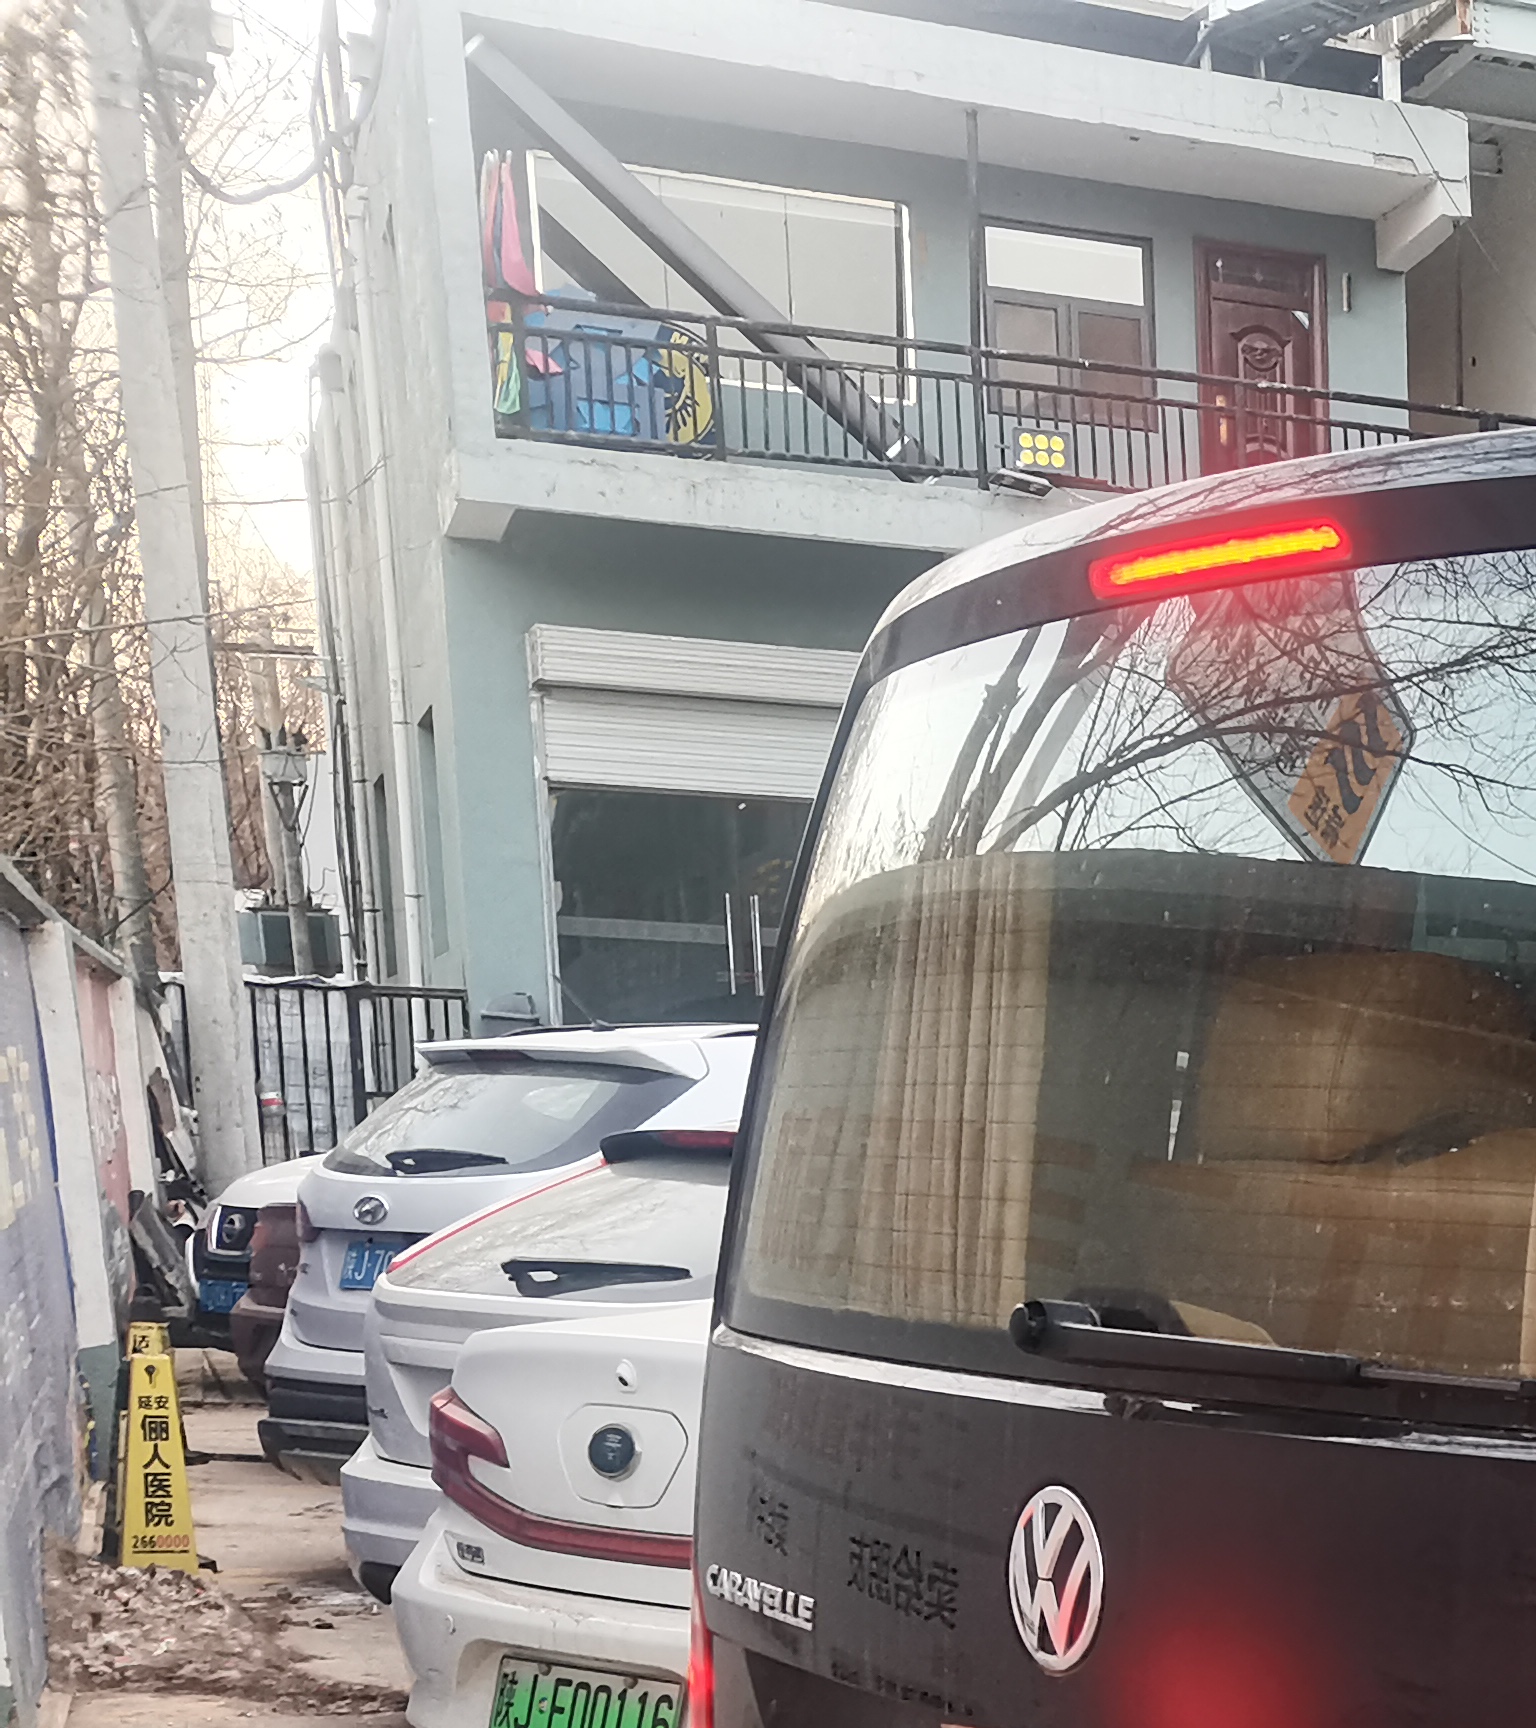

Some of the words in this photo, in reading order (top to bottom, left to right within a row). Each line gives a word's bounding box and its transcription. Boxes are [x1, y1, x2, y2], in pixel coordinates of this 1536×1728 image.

[138, 1395, 169, 1410] 延安
[140, 1414, 174, 1528] 俪人医院
[131, 1534, 190, 1549] 2660000
